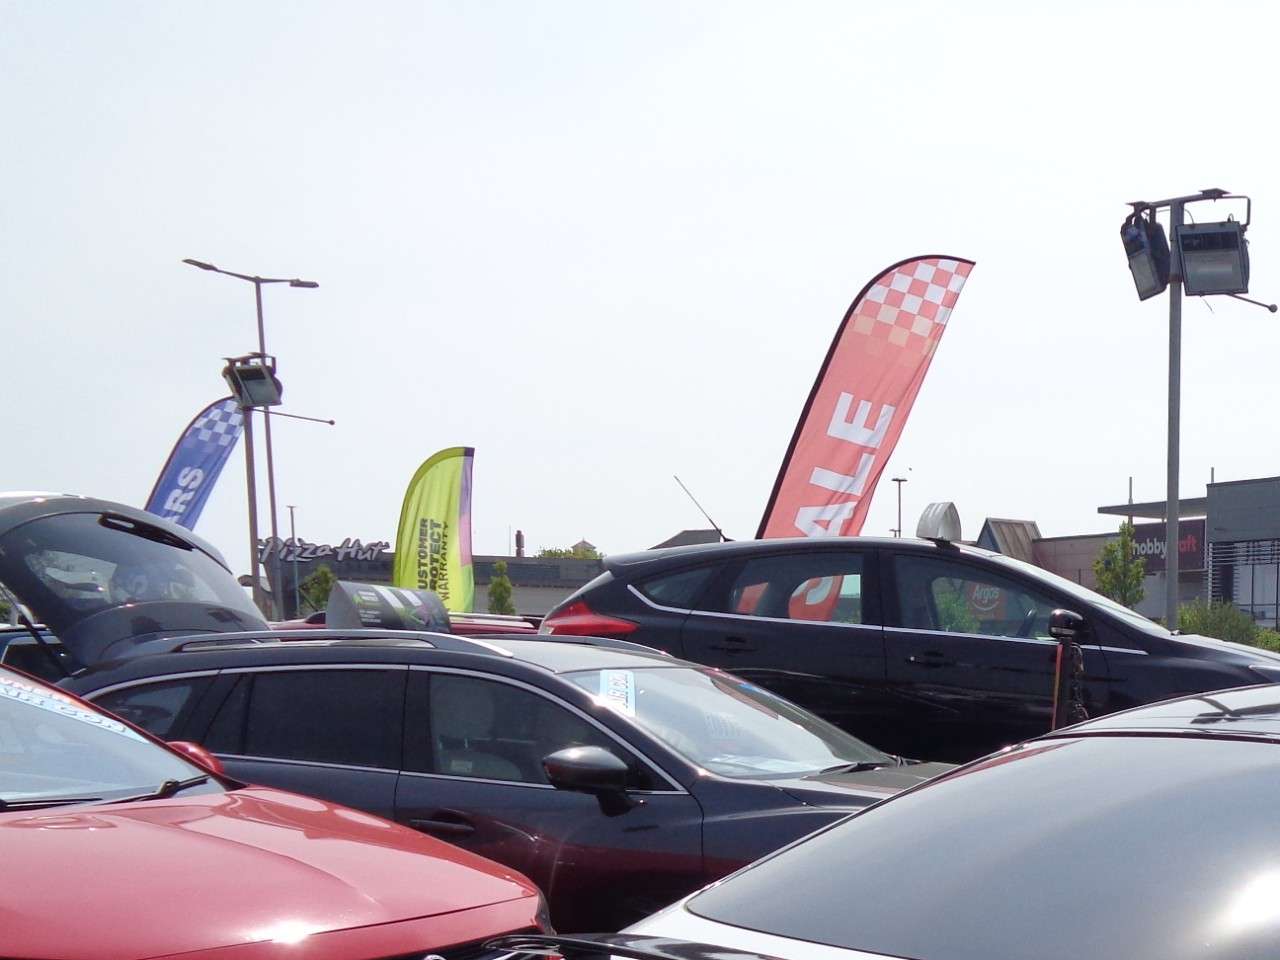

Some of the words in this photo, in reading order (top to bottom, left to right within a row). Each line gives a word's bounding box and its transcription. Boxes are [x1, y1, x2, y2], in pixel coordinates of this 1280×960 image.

[257, 536, 334, 563] Pizza
[334, 537, 391, 562] Hut
[416, 517, 429, 590] USTOMER
[429, 518, 443, 592] ROTECT
[437, 521, 450, 601] WARRANTY
